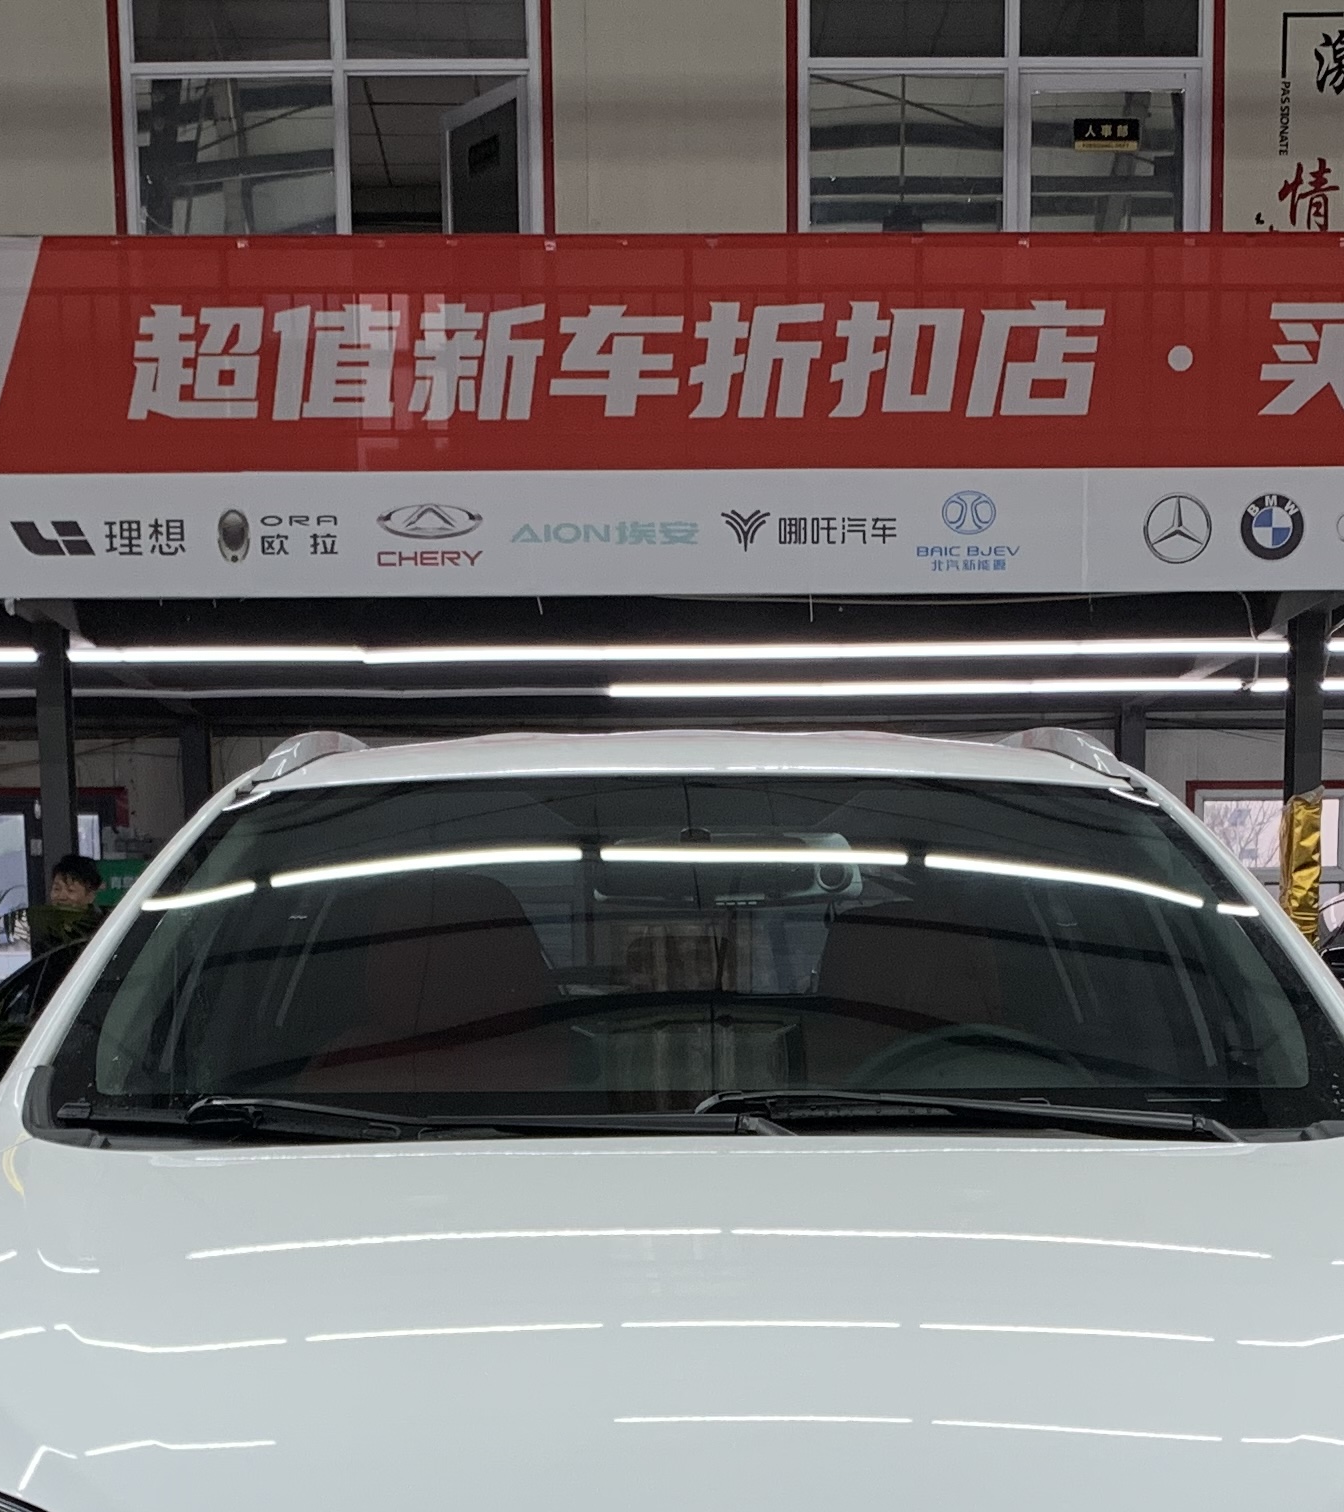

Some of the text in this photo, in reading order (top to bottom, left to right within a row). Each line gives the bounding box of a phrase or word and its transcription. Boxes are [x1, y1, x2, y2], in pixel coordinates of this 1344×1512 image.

[1278, 80, 1291, 157] PASSIONATE
[1277, 157, 1340, 232] 情
[1246, 494, 1300, 518] BMW
[259, 514, 339, 527] ORA
[103, 517, 187, 557] 理想
[260, 533, 339, 556] 欧拉
[376, 550, 484, 568] CHERY
[916, 545, 1021, 557] BAIC BJEV
